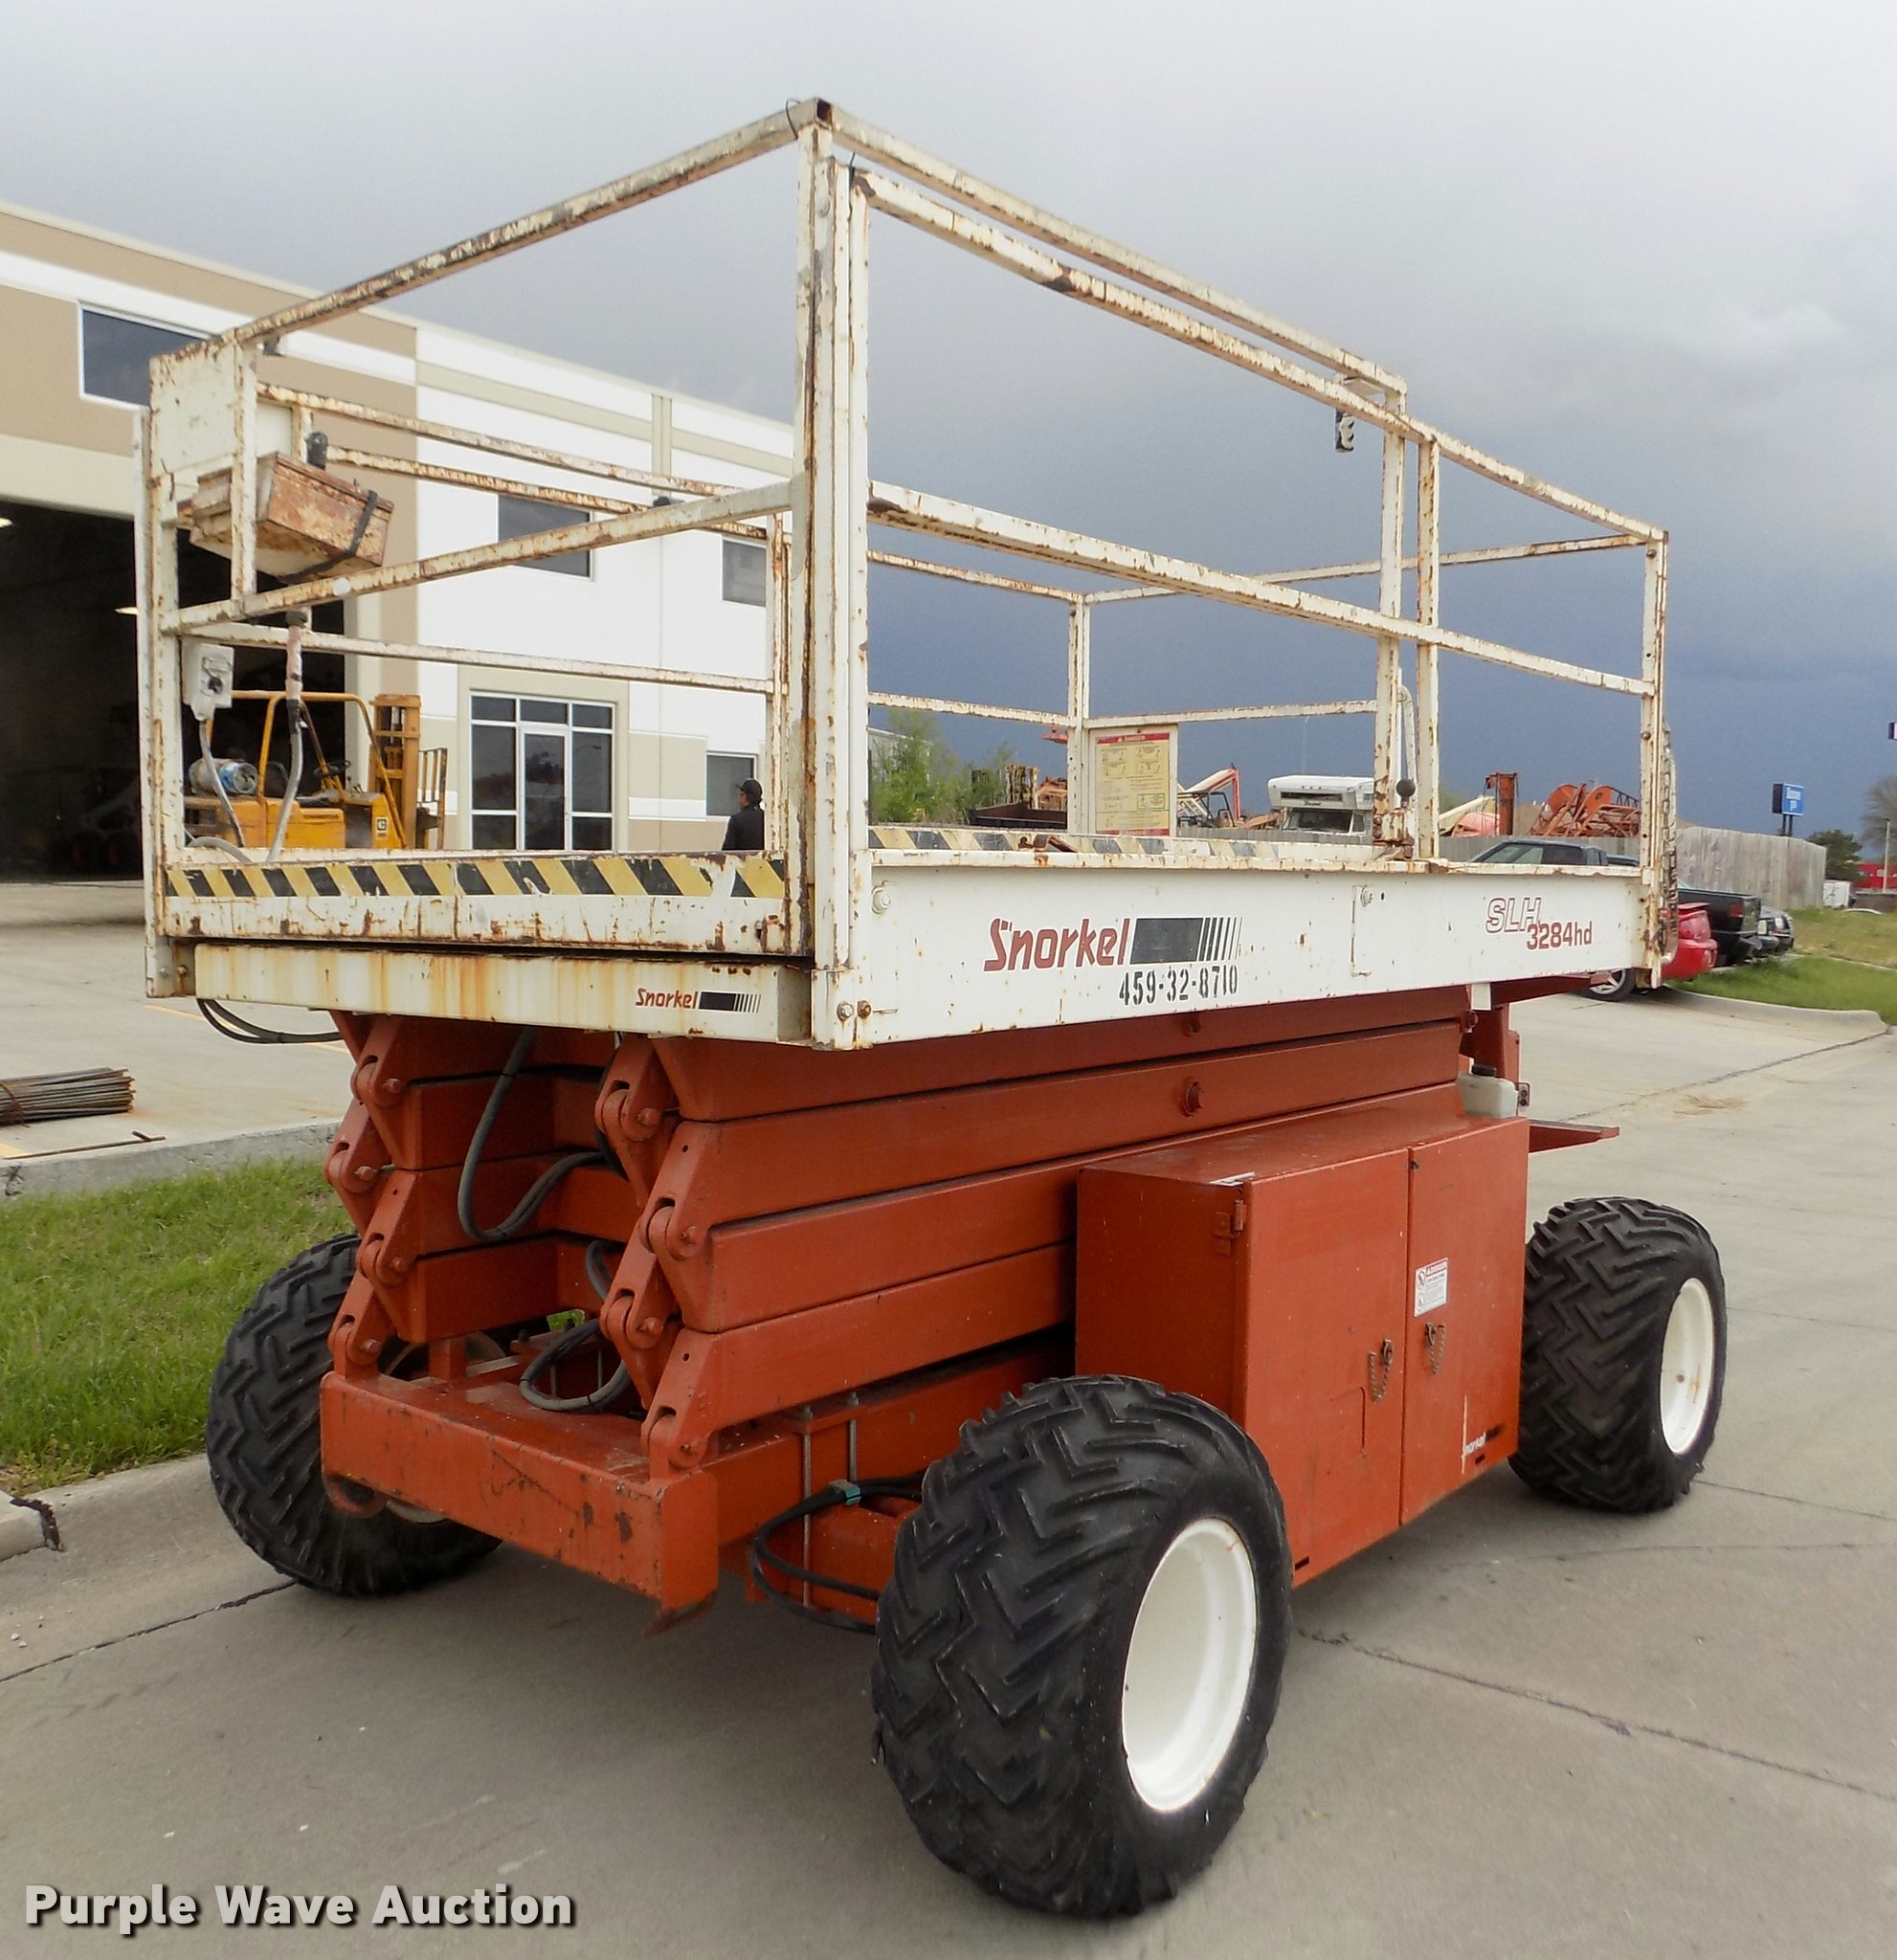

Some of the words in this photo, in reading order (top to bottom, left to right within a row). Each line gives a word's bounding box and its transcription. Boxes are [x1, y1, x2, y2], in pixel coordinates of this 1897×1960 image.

[1485, 897, 1542, 934] SLH
[983, 917, 1130, 971] Snorkel
[1526, 920, 1593, 949] 3284hd
[635, 987, 699, 1010] Snorkel
